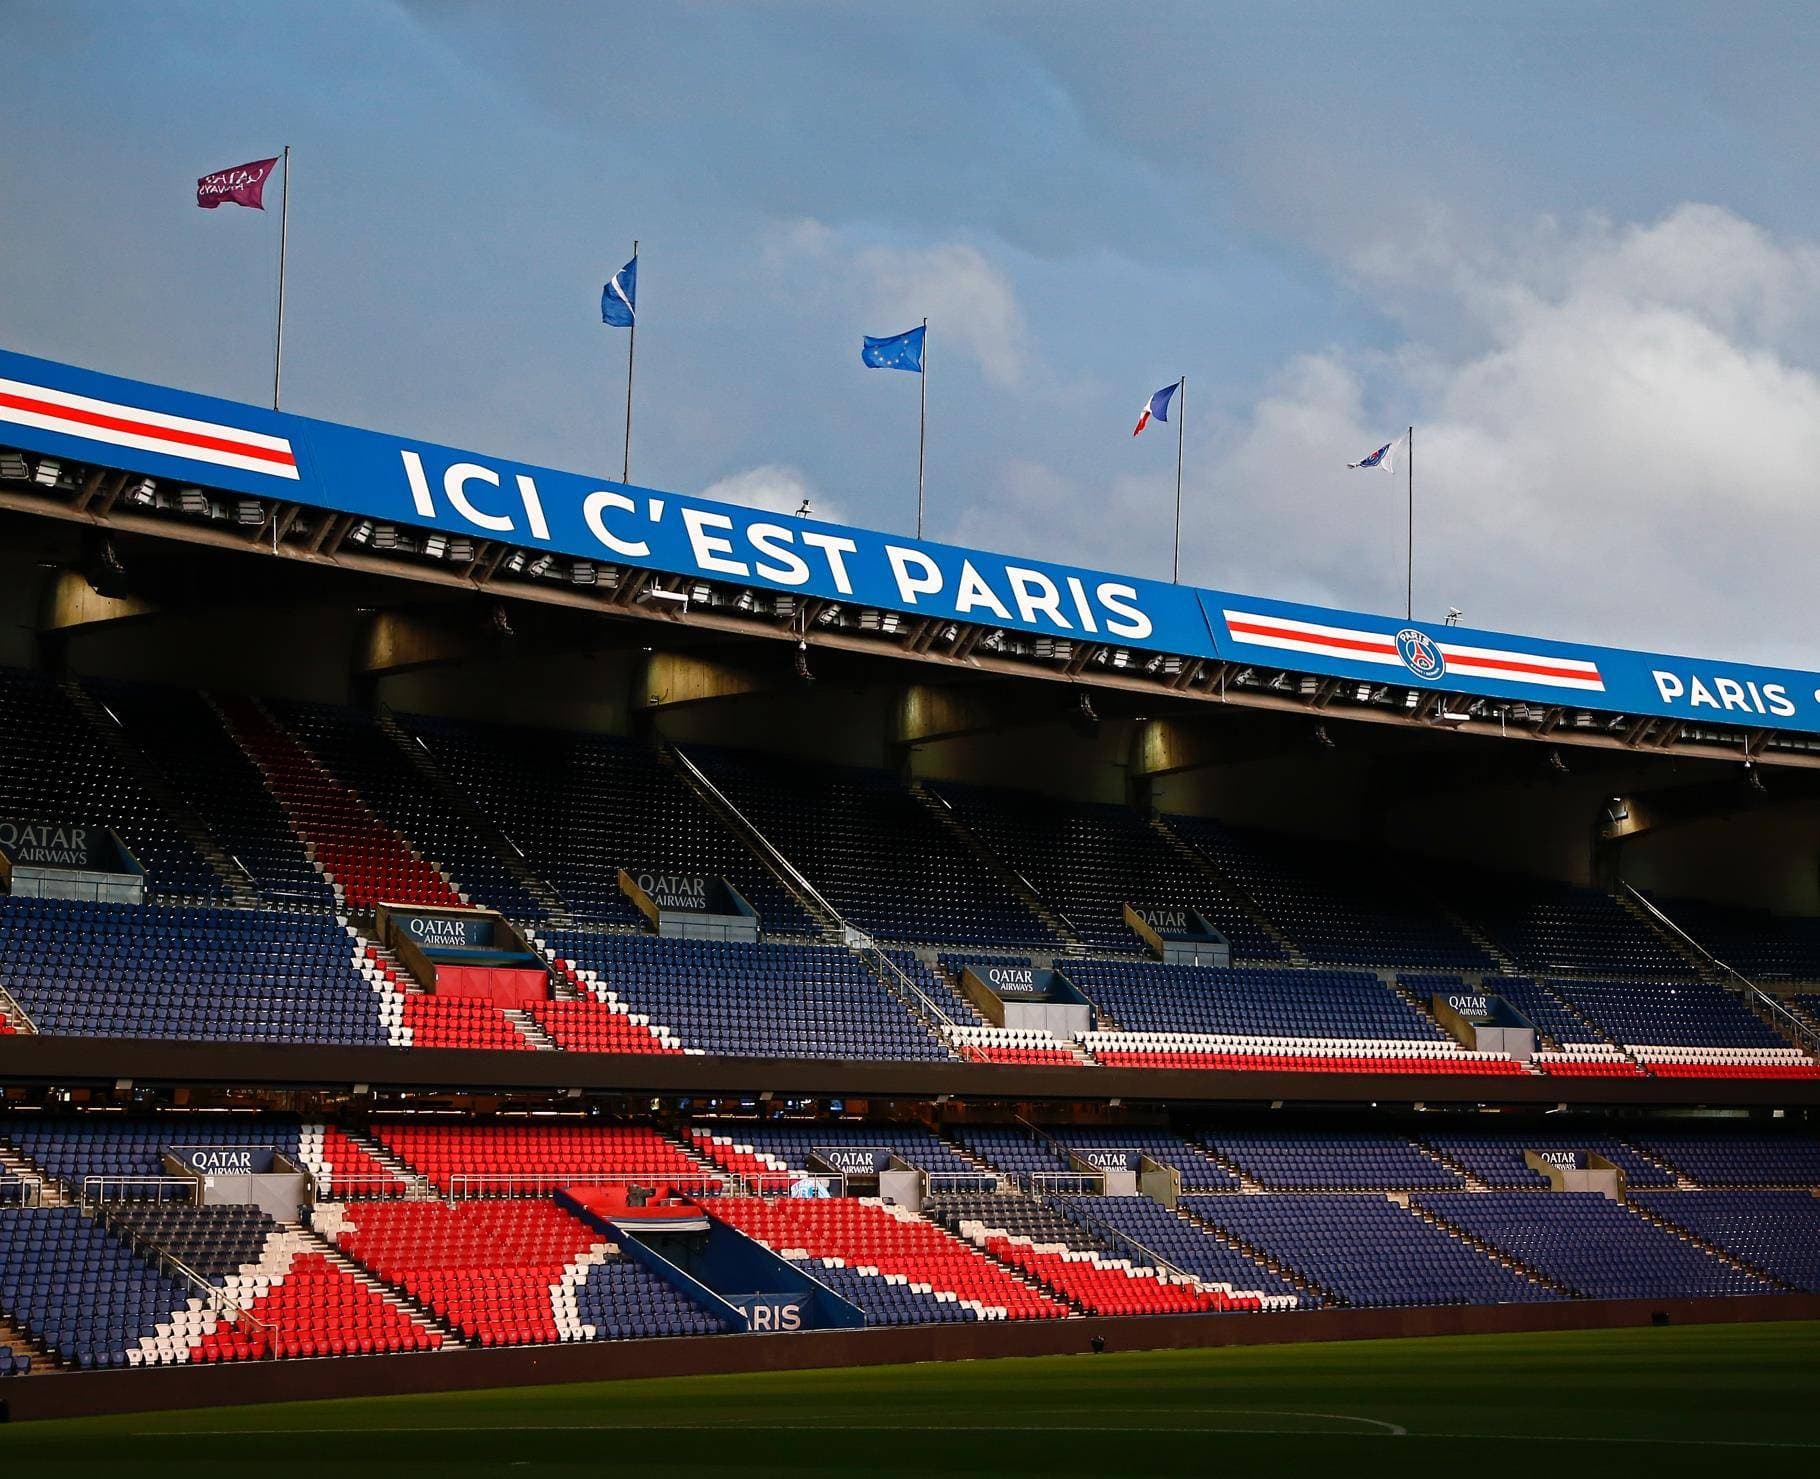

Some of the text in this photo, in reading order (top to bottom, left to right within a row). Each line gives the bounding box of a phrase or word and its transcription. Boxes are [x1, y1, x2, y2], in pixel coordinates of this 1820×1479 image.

[400, 450, 1153, 640] ICI C'EST PARIS
[1400, 631, 1430, 646] PARIS
[1651, 670, 1796, 717] PARIS
[0, 823, 88, 849] QATAR
[18, 847, 88, 865] AIRWAYS
[637, 874, 706, 896] QATAR
[654, 895, 706, 909] AIRWAYS
[410, 918, 466, 937] QATAR
[424, 935, 466, 946] AIRWAYS
[989, 969, 1033, 985] QATAR
[1000, 982, 1034, 992] AIRWAYS
[1449, 995, 1487, 1010] QATAR
[1459, 1008, 1488, 1017] AIRWAYS
[192, 1152, 252, 1170] QATAR
[829, 1152, 874, 1169] QATAR
[207, 1167, 252, 1175] AIRWAYS
[841, 1165, 874, 1174] AIRWAYS
